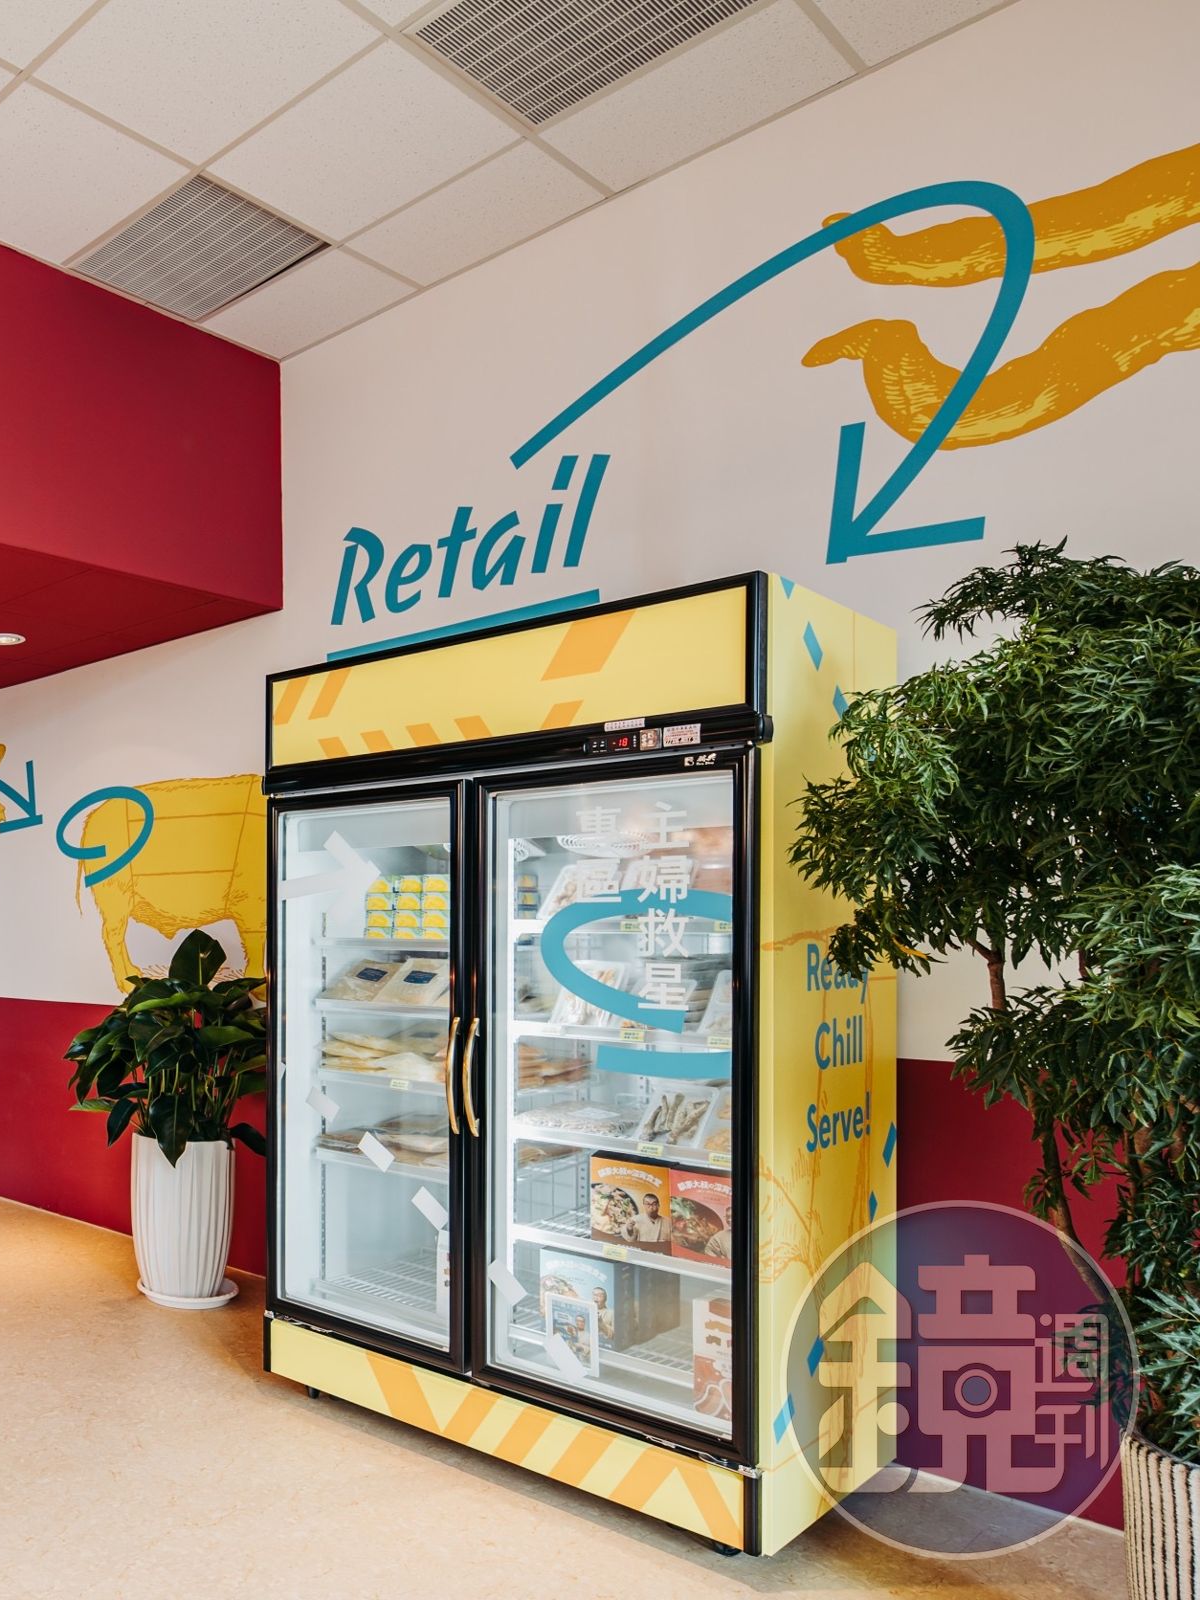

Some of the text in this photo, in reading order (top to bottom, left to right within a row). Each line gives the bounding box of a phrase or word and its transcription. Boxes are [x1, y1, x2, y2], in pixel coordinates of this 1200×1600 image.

[330, 453, 611, 626] Retail
[575, 806, 622, 903] 專區
[637, 801, 691, 1011] 主婦救星
[815, 1014, 863, 1070] Chill
[806, 1091, 871, 1153] Serve!
